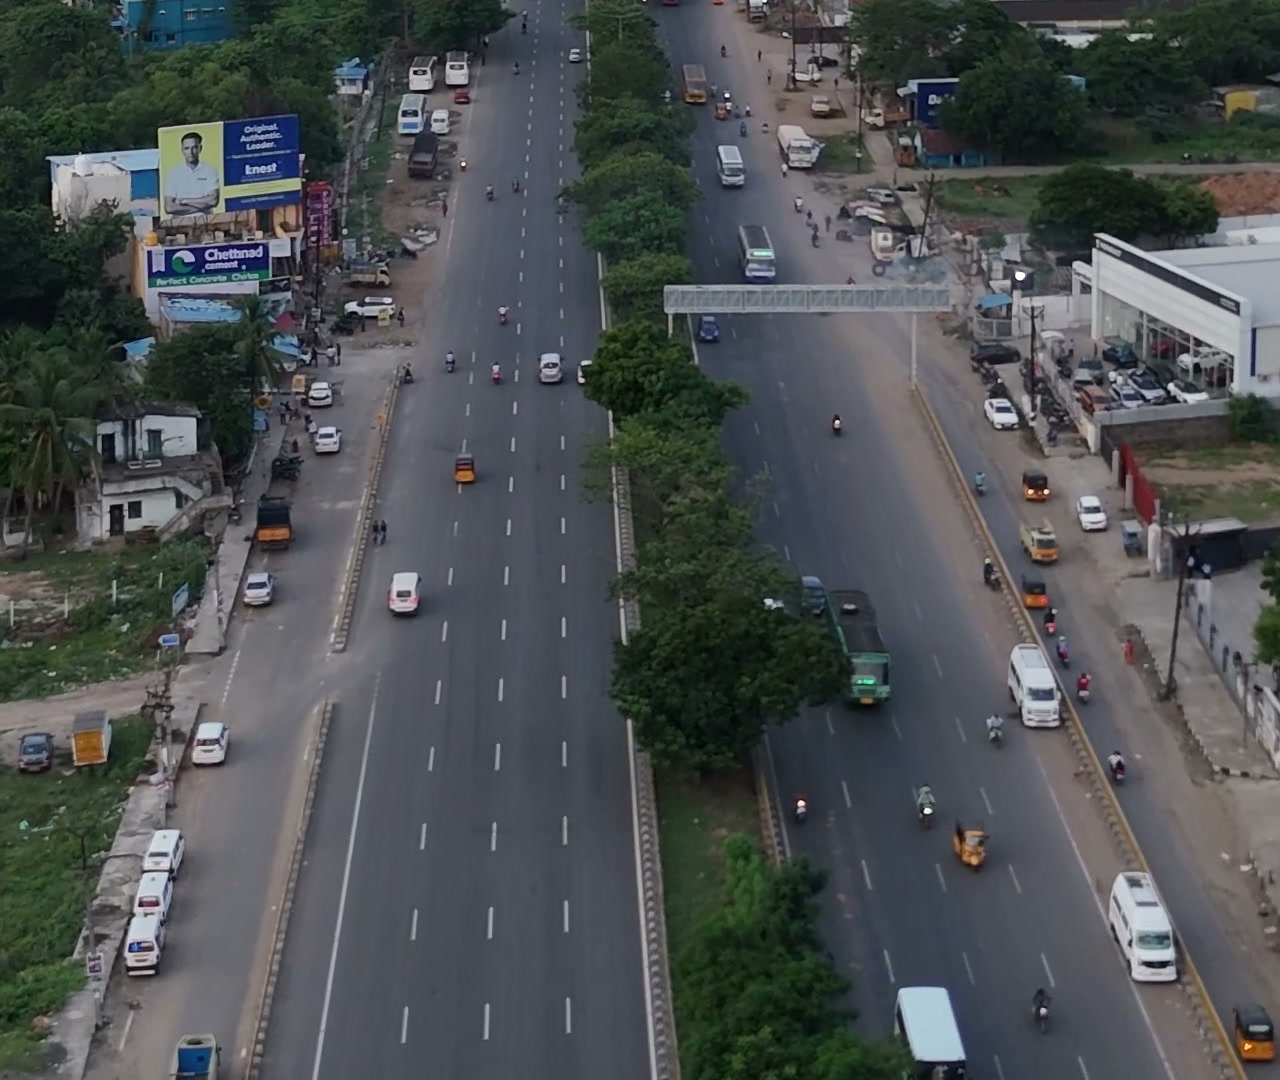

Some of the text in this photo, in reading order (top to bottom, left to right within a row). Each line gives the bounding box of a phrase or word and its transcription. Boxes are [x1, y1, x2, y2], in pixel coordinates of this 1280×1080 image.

[244, 123, 278, 133] Original.
[240, 131, 282, 142] Authentic.
[245, 163, 277, 175] knest
[204, 245, 263, 261] Chettinad
[205, 261, 238, 270] cement
[156, 277, 187, 286] Perfect
[190, 275, 227, 284] Concrete
